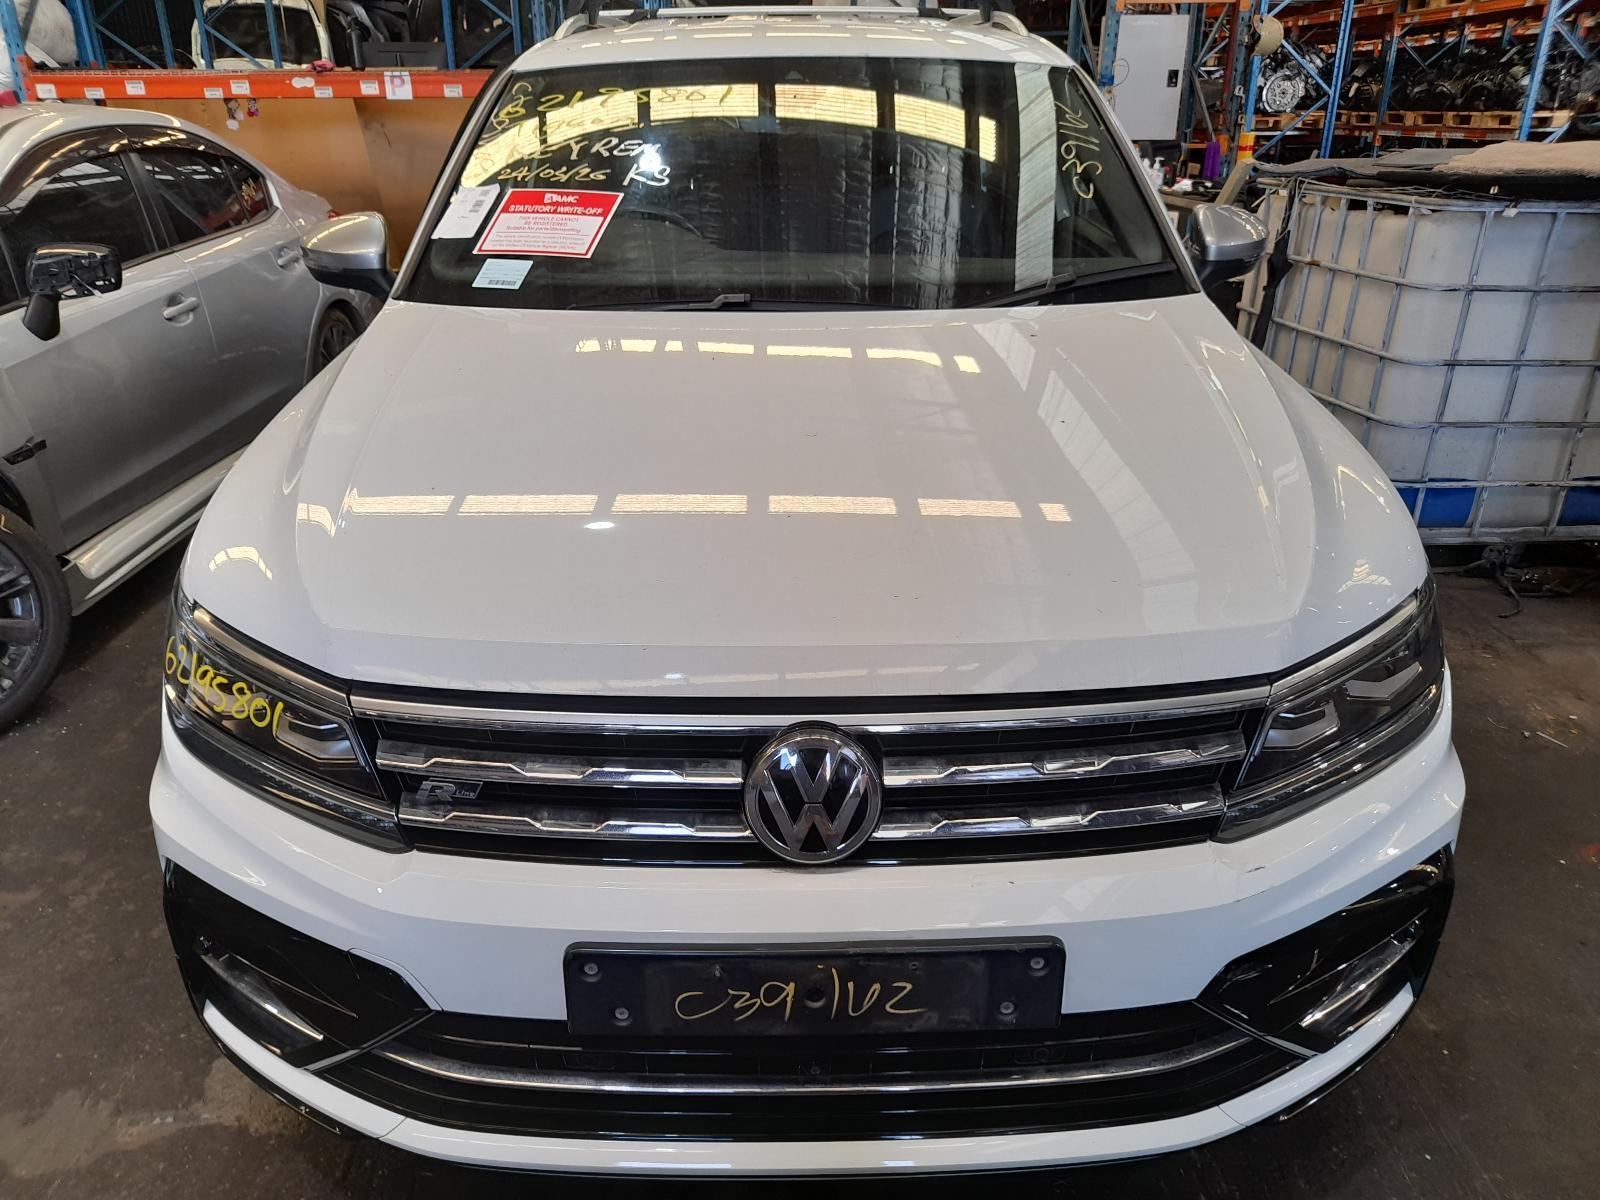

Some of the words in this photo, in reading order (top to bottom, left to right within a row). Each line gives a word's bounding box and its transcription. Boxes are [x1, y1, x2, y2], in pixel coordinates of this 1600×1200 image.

[508, 204, 557, 213] STATUTORY
[557, 205, 604, 215] WRITE-OFF
[165, 635, 285, 738] 62195801
